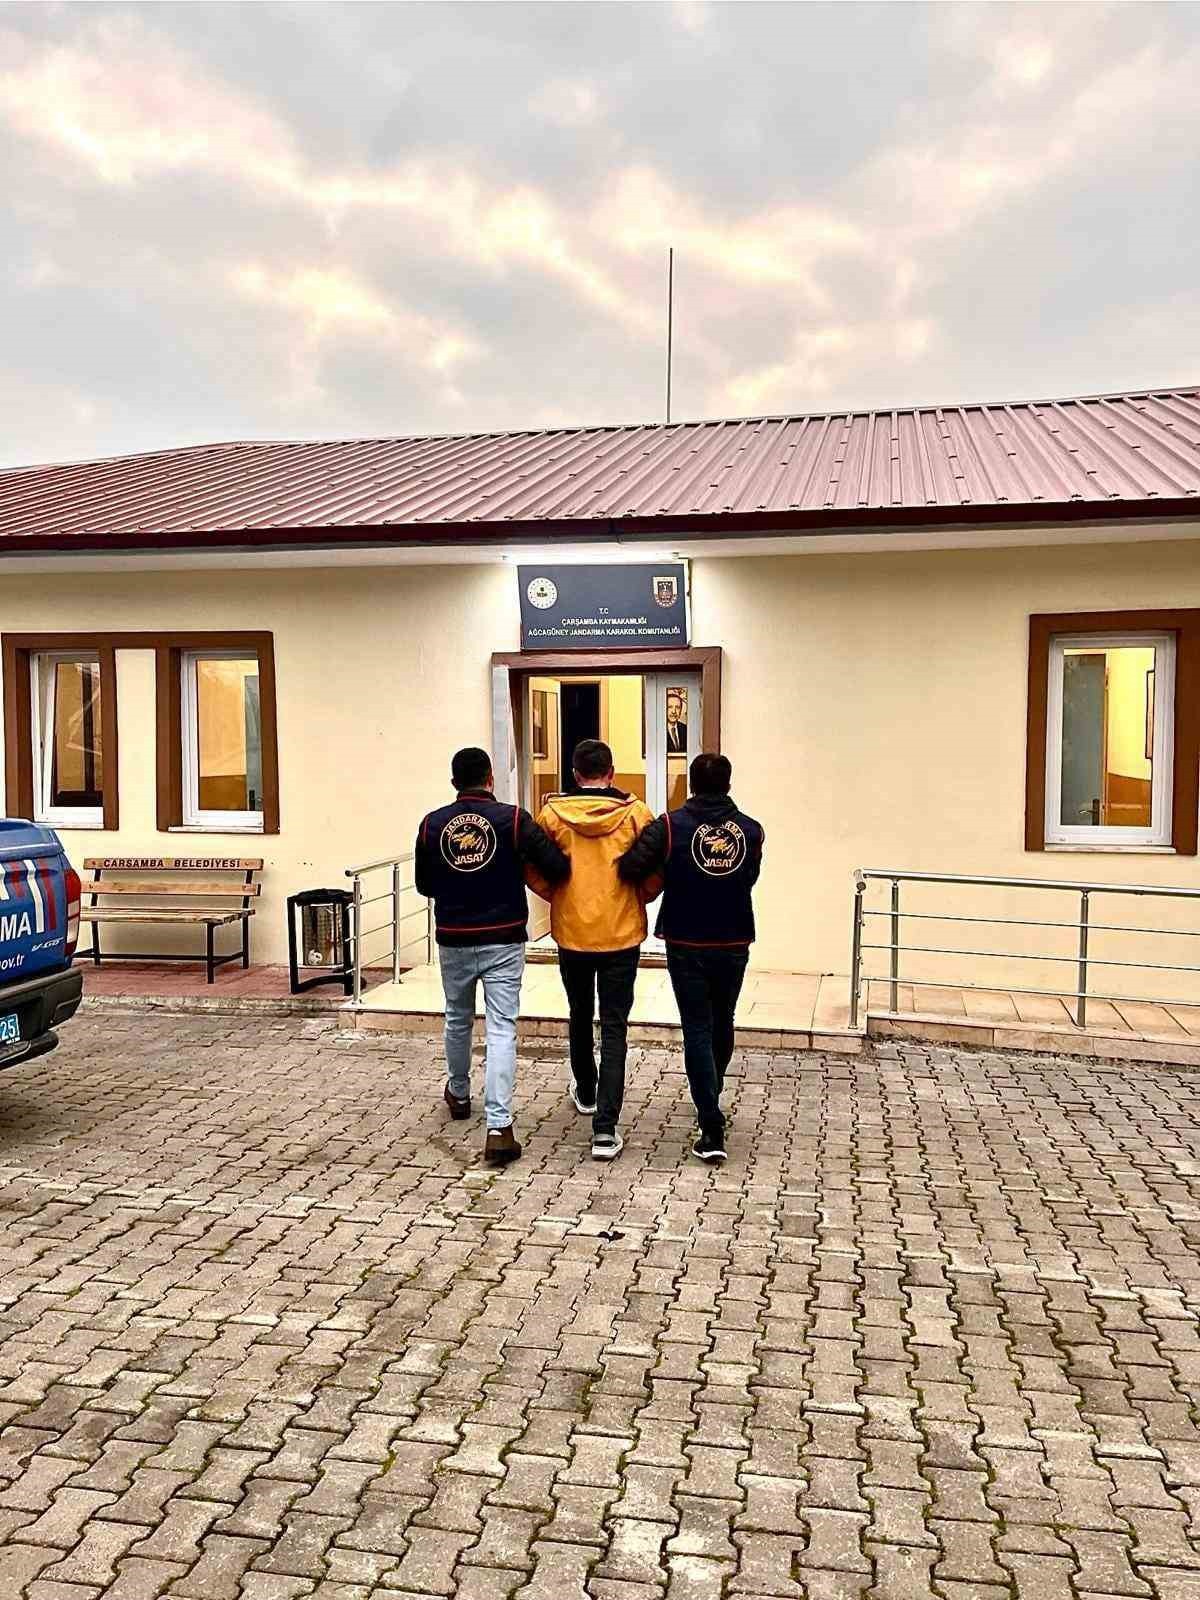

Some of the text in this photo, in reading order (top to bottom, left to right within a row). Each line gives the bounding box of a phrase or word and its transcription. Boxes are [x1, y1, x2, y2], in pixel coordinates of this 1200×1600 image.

[570, 628, 606, 636] JANDARMA
[607, 628, 635, 636] KARAKOL
[638, 626, 680, 635] KOMUTANLIĞI
[446, 815, 490, 837] JANDARMA
[454, 853, 484, 865] JASAT
[703, 858, 734, 868] JASAT
